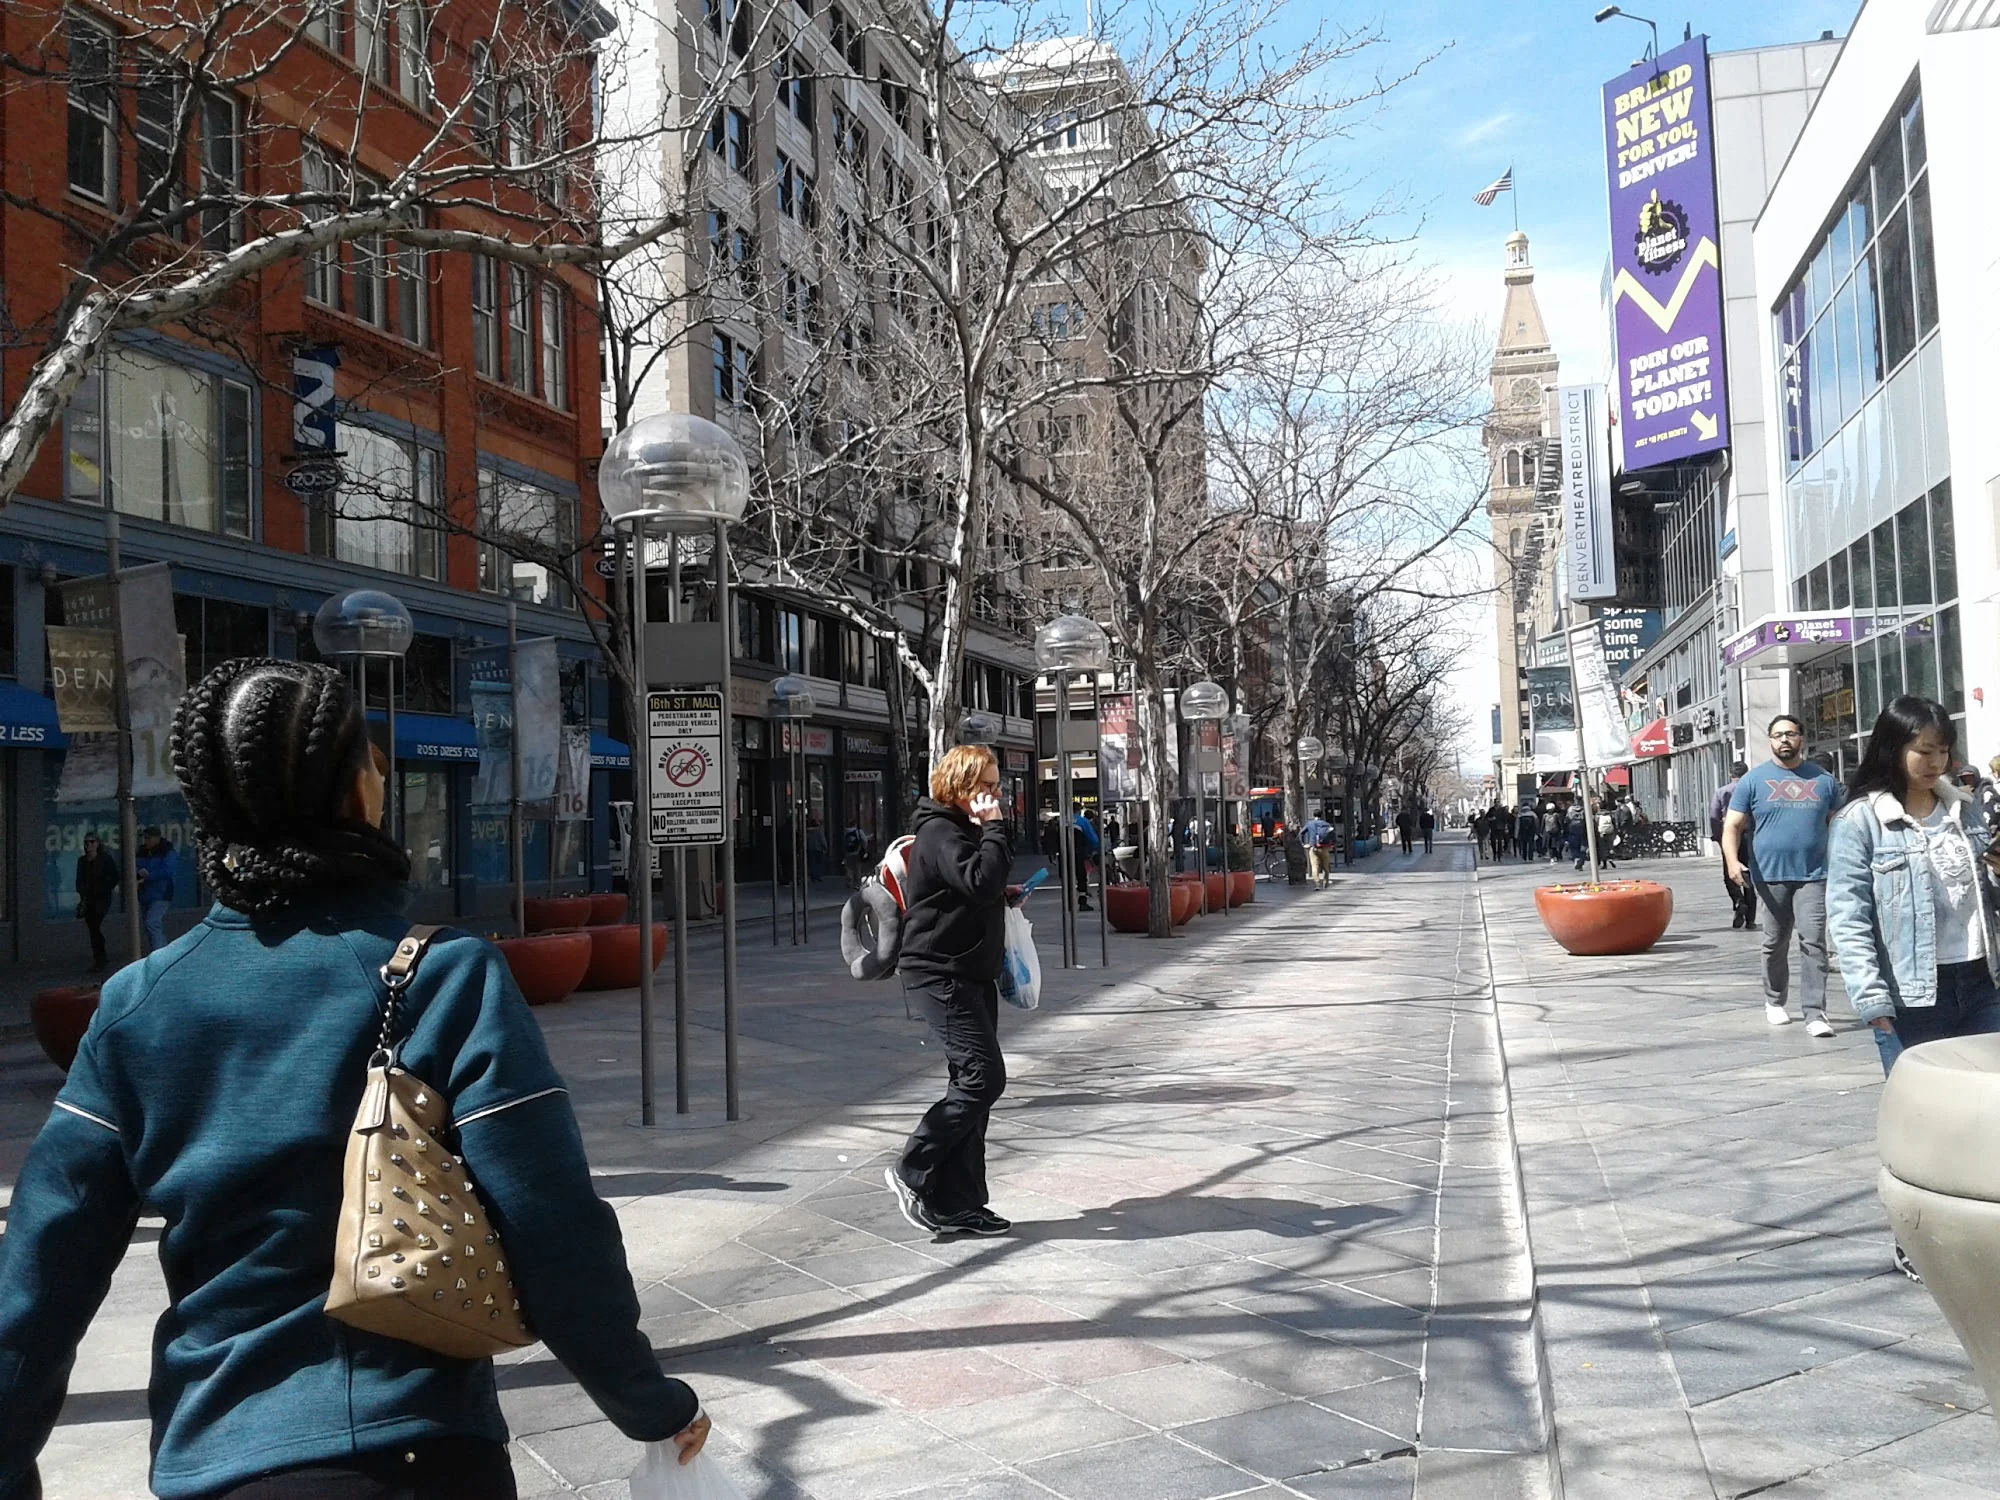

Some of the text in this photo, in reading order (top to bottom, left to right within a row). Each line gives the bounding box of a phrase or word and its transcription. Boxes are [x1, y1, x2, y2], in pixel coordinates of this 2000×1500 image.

[1614, 64, 1693, 117] BRAND
[1616, 86, 1694, 148] NEW
[1617, 120, 1698, 168] FOR YOU,
[1618, 140, 1698, 189] DENVER!
[1638, 226, 1678, 257] planet
[1644, 238, 1686, 264] fitness
[1630, 336, 1709, 379] JOIN OUR
[1630, 356, 1710, 397] PLANET
[1631, 379, 1713, 421] TODAY!
[64, 606, 112, 625] STREET
[1604, 617, 1643, 631] some
[1794, 619, 1835, 633] planet
[1604, 632, 1639, 646] time
[1605, 647, 1630, 661] not
[471, 659, 497, 671] 16TH
[471, 668, 509, 681] STREET
[53, 666, 114, 689] DEN
[649, 697, 671, 710] 16th
[692, 696, 721, 709] MALL
[1531, 691, 1573, 708] DEN
[473, 711, 513, 730] DEN
[652, 719, 718, 728] AUTHORIZED VEHICLES
[657, 712, 698, 720] PEDESTRIANS
[11, 725, 45, 742] LESS
[416, 744, 479, 758] ROSS DRESS FOR
[658, 741, 682, 769] MONDAY
[693, 742, 714, 768] FRIDAY
[605, 755, 617, 766] FOR
[616, 756, 631, 767] LESS
[651, 792, 686, 800] SATURDAYS
[694, 790, 721, 798] SUNDAYS
[1224, 778, 1246, 797] 16
[1764, 779, 1820, 801] XX
[563, 791, 585, 814] 16
[652, 815, 666, 830] NO
